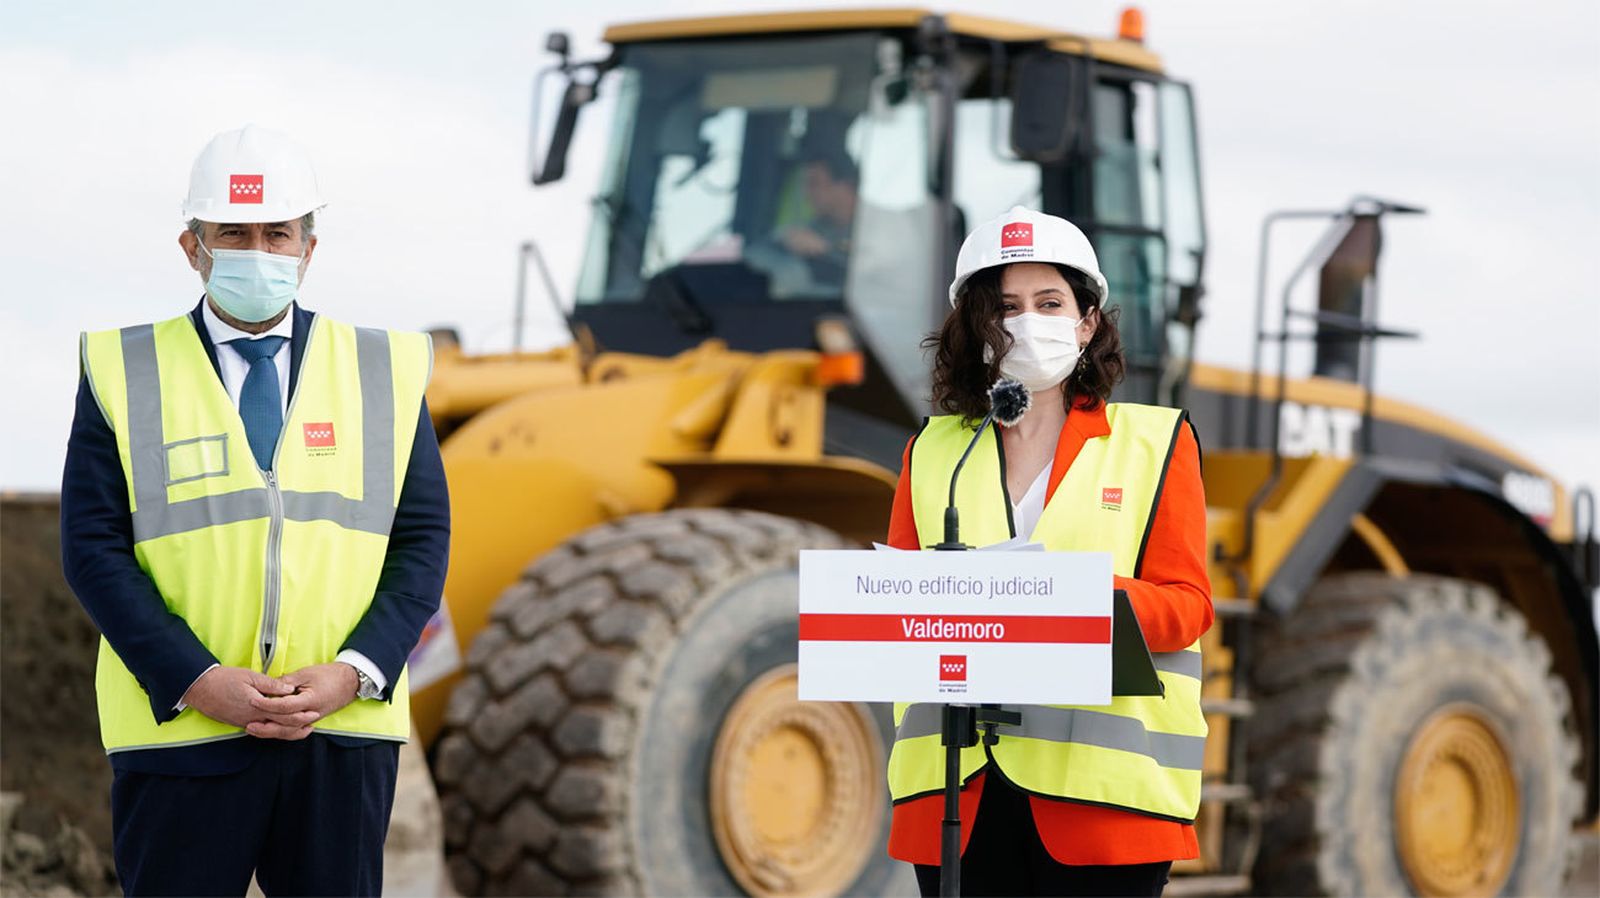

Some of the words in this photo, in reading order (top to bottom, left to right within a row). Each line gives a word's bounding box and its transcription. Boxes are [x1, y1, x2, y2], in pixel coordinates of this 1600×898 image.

[1279, 400, 1362, 460] CAT
[857, 575, 912, 594] Nuevo
[919, 576, 983, 596] edificio
[989, 576, 1053, 600] judicial
[901, 617, 1005, 640] Valdemoro
